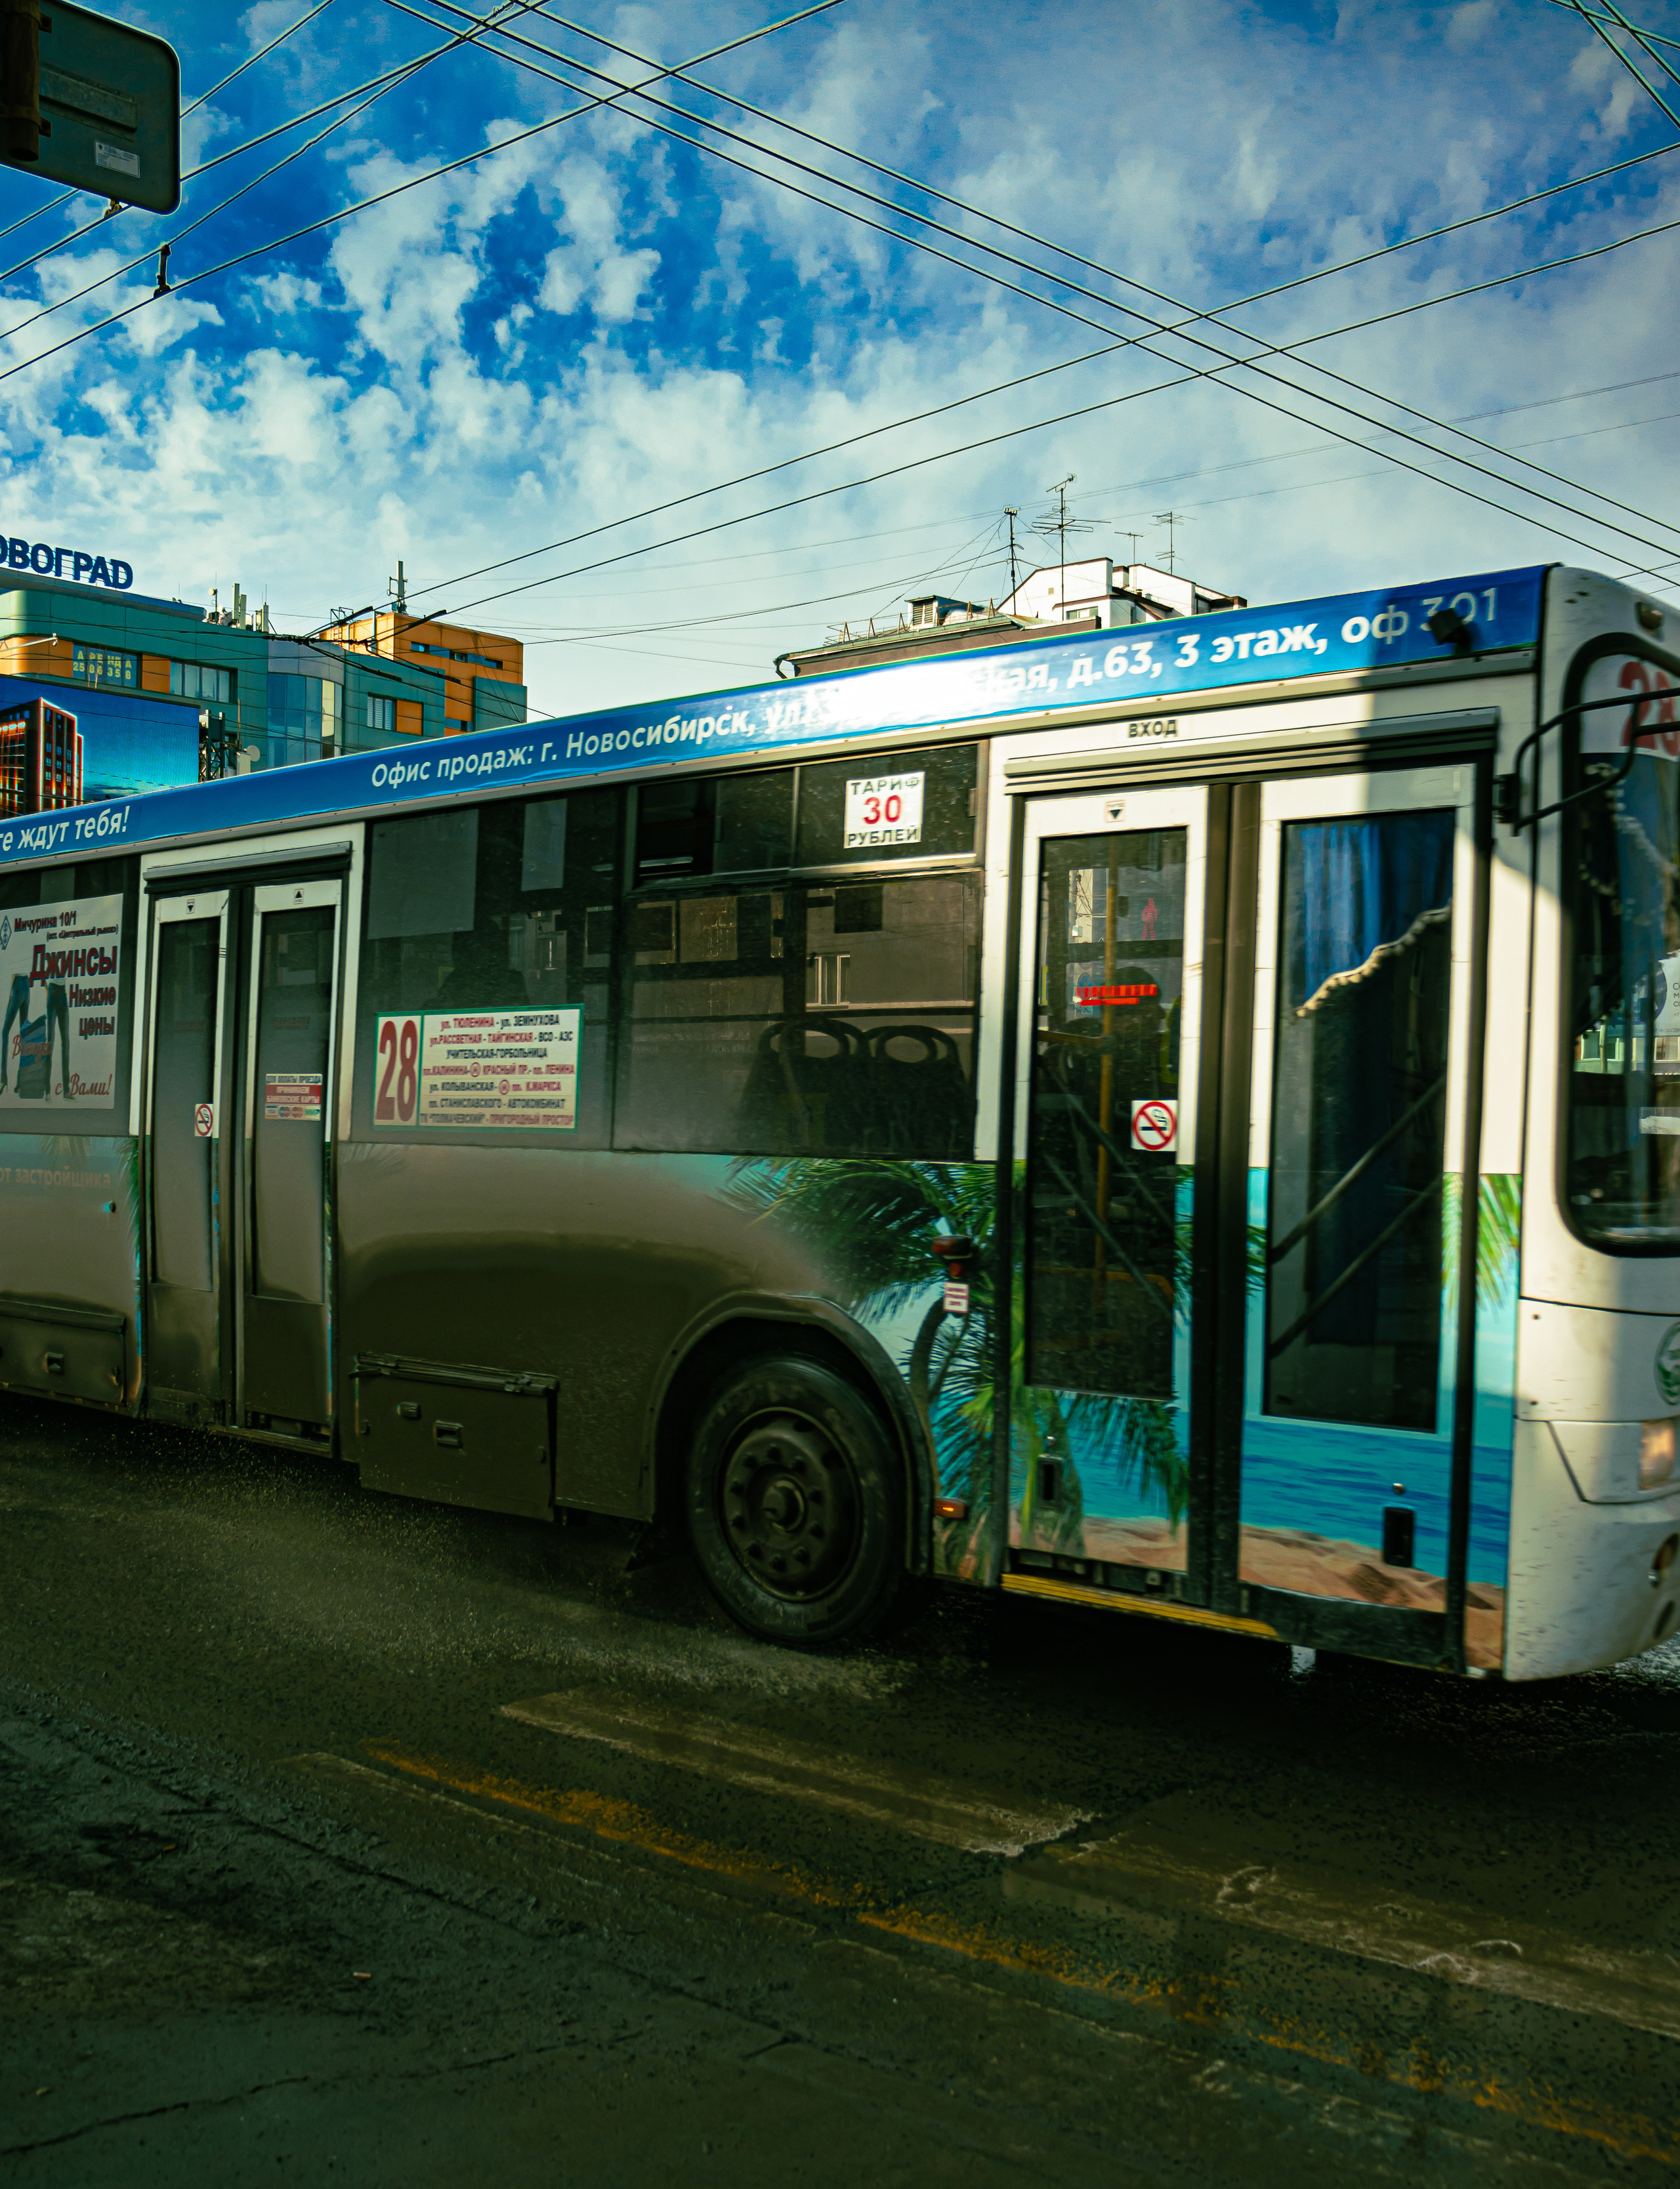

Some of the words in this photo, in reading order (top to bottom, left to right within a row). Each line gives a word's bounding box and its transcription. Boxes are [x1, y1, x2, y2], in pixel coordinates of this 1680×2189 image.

[1067, 640, 1163, 688] д.63,
[1174, 634, 1201, 669] 3
[1210, 619, 1328, 664] этаж,
[1618, 661, 1680, 757] 28
[1128, 719, 1177, 738] ВХОД
[371, 751, 430, 789] Офис
[437, 742, 535, 781] продаж:
[540, 741, 558, 763] г.
[566, 709, 757, 759] Новосибирск,
[851, 776, 919, 795] ТАРИФ
[863, 795, 902, 825] 30
[17, 822, 70, 851] ждут
[75, 805, 131, 840] тебя!
[848, 825, 917, 846] РУБЛЕЙ
[14, 917, 58, 934] Мичурина
[60, 910, 77, 927] 10/1
[29, 944, 117, 988] Джинсы
[68, 984, 116, 1008] Низкие
[79, 1016, 115, 1040] цены
[12, 1034, 51, 1060] Всегда
[375, 1019, 418, 1123] 28
[482, 1062, 517, 1075] КРАСНЫЙ
[545, 1064, 576, 1075] ЛЕНИНА
[54, 1083, 63, 1096] с
[69, 1072, 113, 1096] Вами!
[439, 1098, 503, 1109] СТАНИСЛАВСКОГО
[507, 1098, 566, 1109] АВТОКОМБИНАТ
[15, 1165, 112, 1190] застройщика
